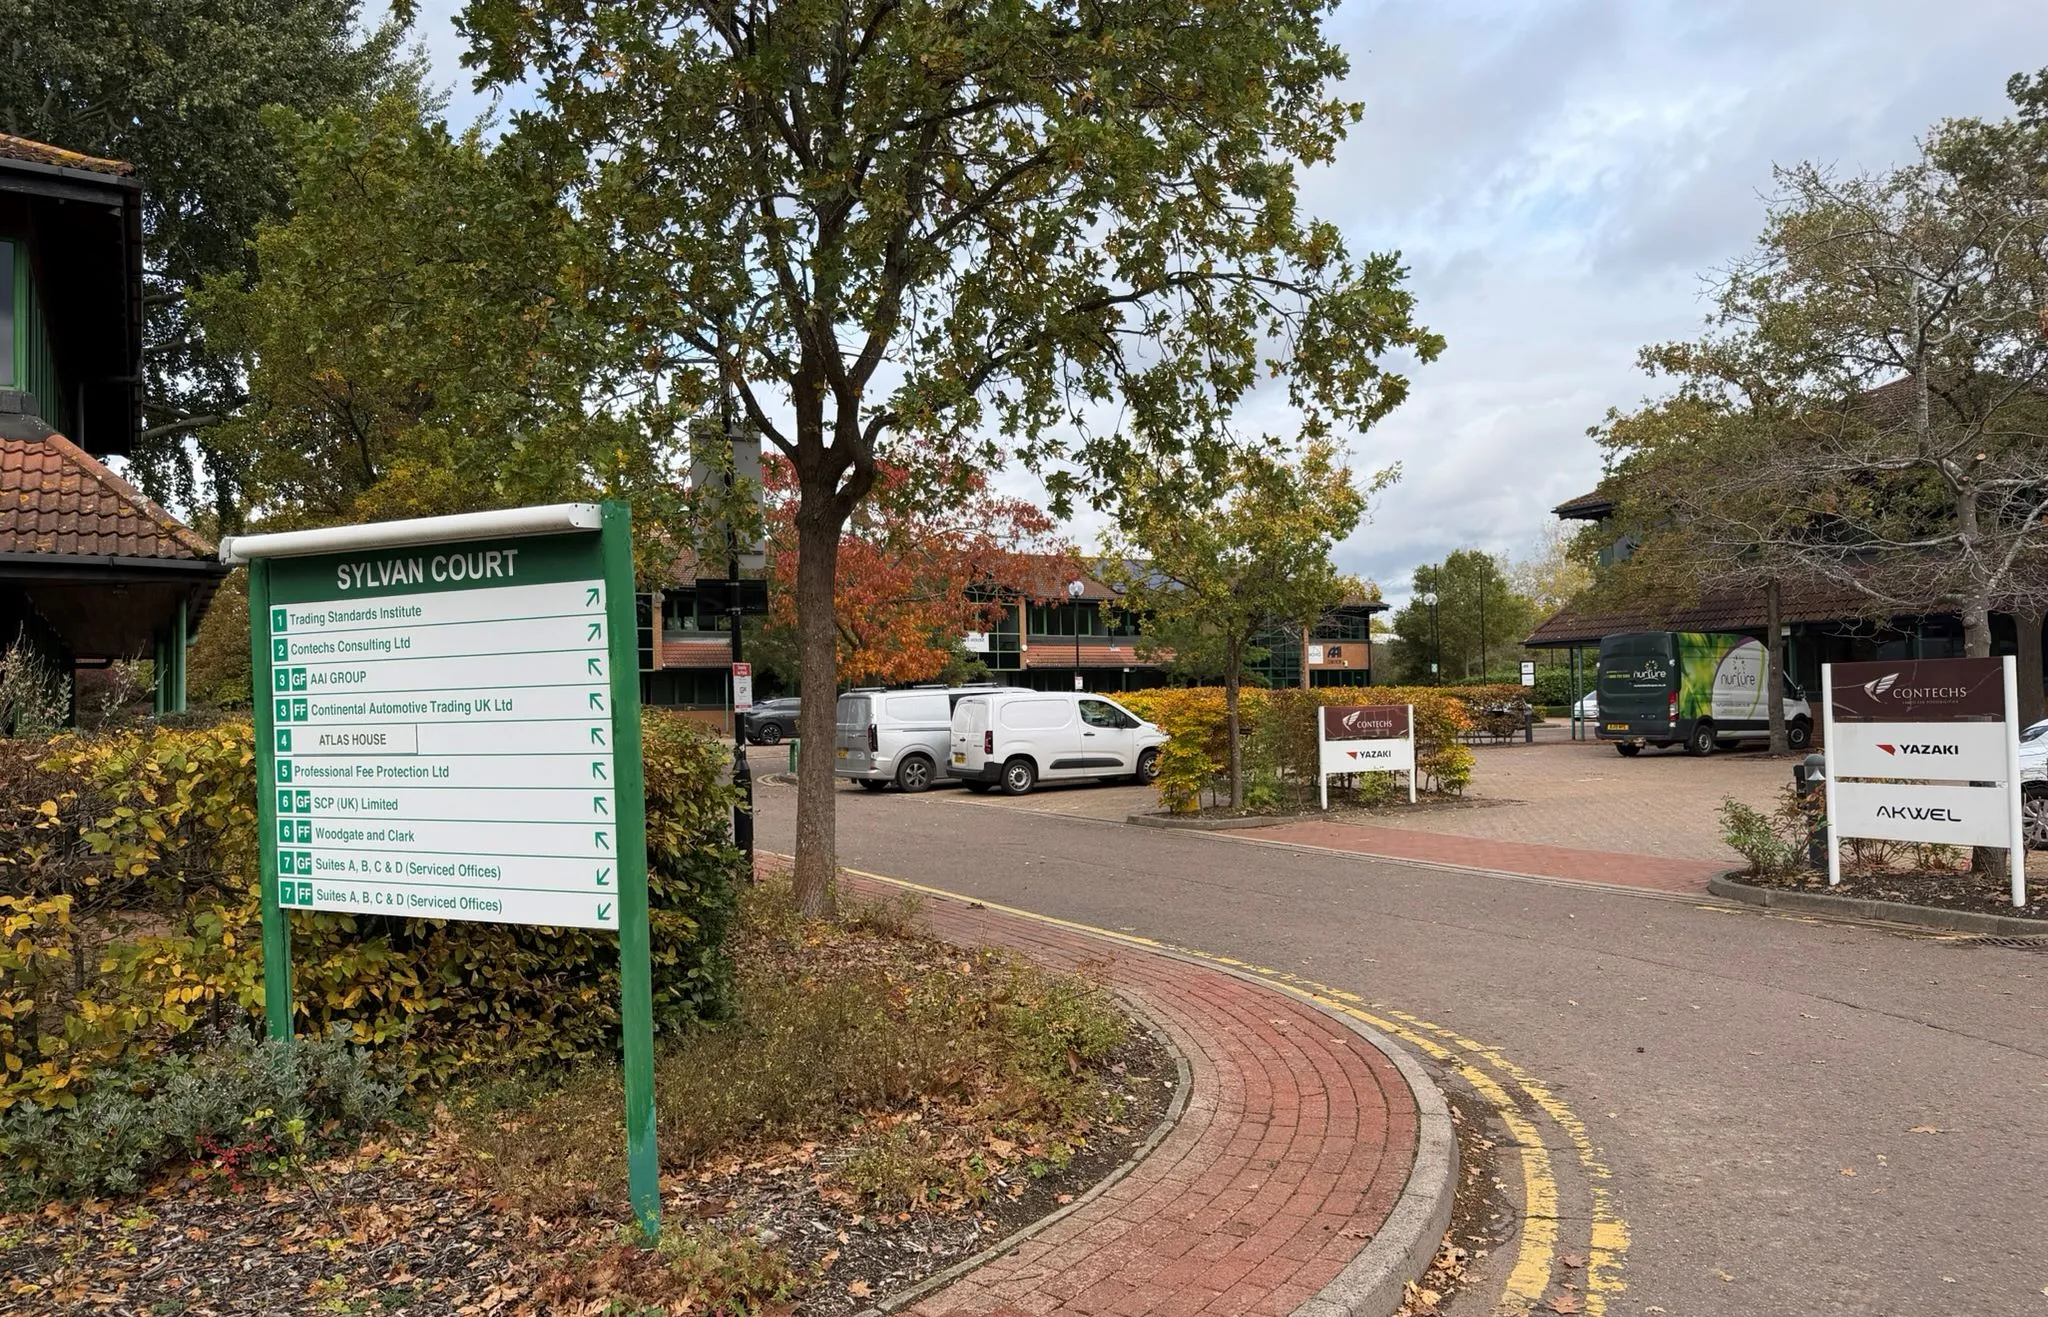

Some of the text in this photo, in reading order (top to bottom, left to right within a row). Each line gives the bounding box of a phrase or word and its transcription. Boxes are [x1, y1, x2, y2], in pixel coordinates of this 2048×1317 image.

[338, 549, 517, 589] SYLVAN COURT
[277, 606, 421, 626] 1 Trading Standards Institute
[278, 637, 410, 656] 2 Contechs Consulting Ltd
[279, 671, 366, 687] 3 GF AAI GROUP
[1633, 668, 1667, 679] nurture
[1721, 671, 1756, 686] nurture
[1893, 687, 1966, 698] CONTECHS
[280, 699, 512, 716] 3 FF Continental Automotive Trading UK Ltd
[1357, 720, 1393, 728] CONTECHS
[280, 734, 386, 746] 4 ATLAS HOUSE
[1900, 745, 1958, 754] YAZAKI
[281, 766, 449, 777] 5 Professional Fee Protection Ltd
[282, 794, 398, 812] 6 GF SCP (UK) Limited
[1877, 806, 1961, 822] AKWEL
[283, 826, 414, 843] 6 FF Woodgate and Clark
[283, 856, 500, 880] 7 GF Suites A, B, C & D (Serviced Offices)
[284, 887, 502, 914] 7 FF Suites A, B, C & D (Serviced Offices)
